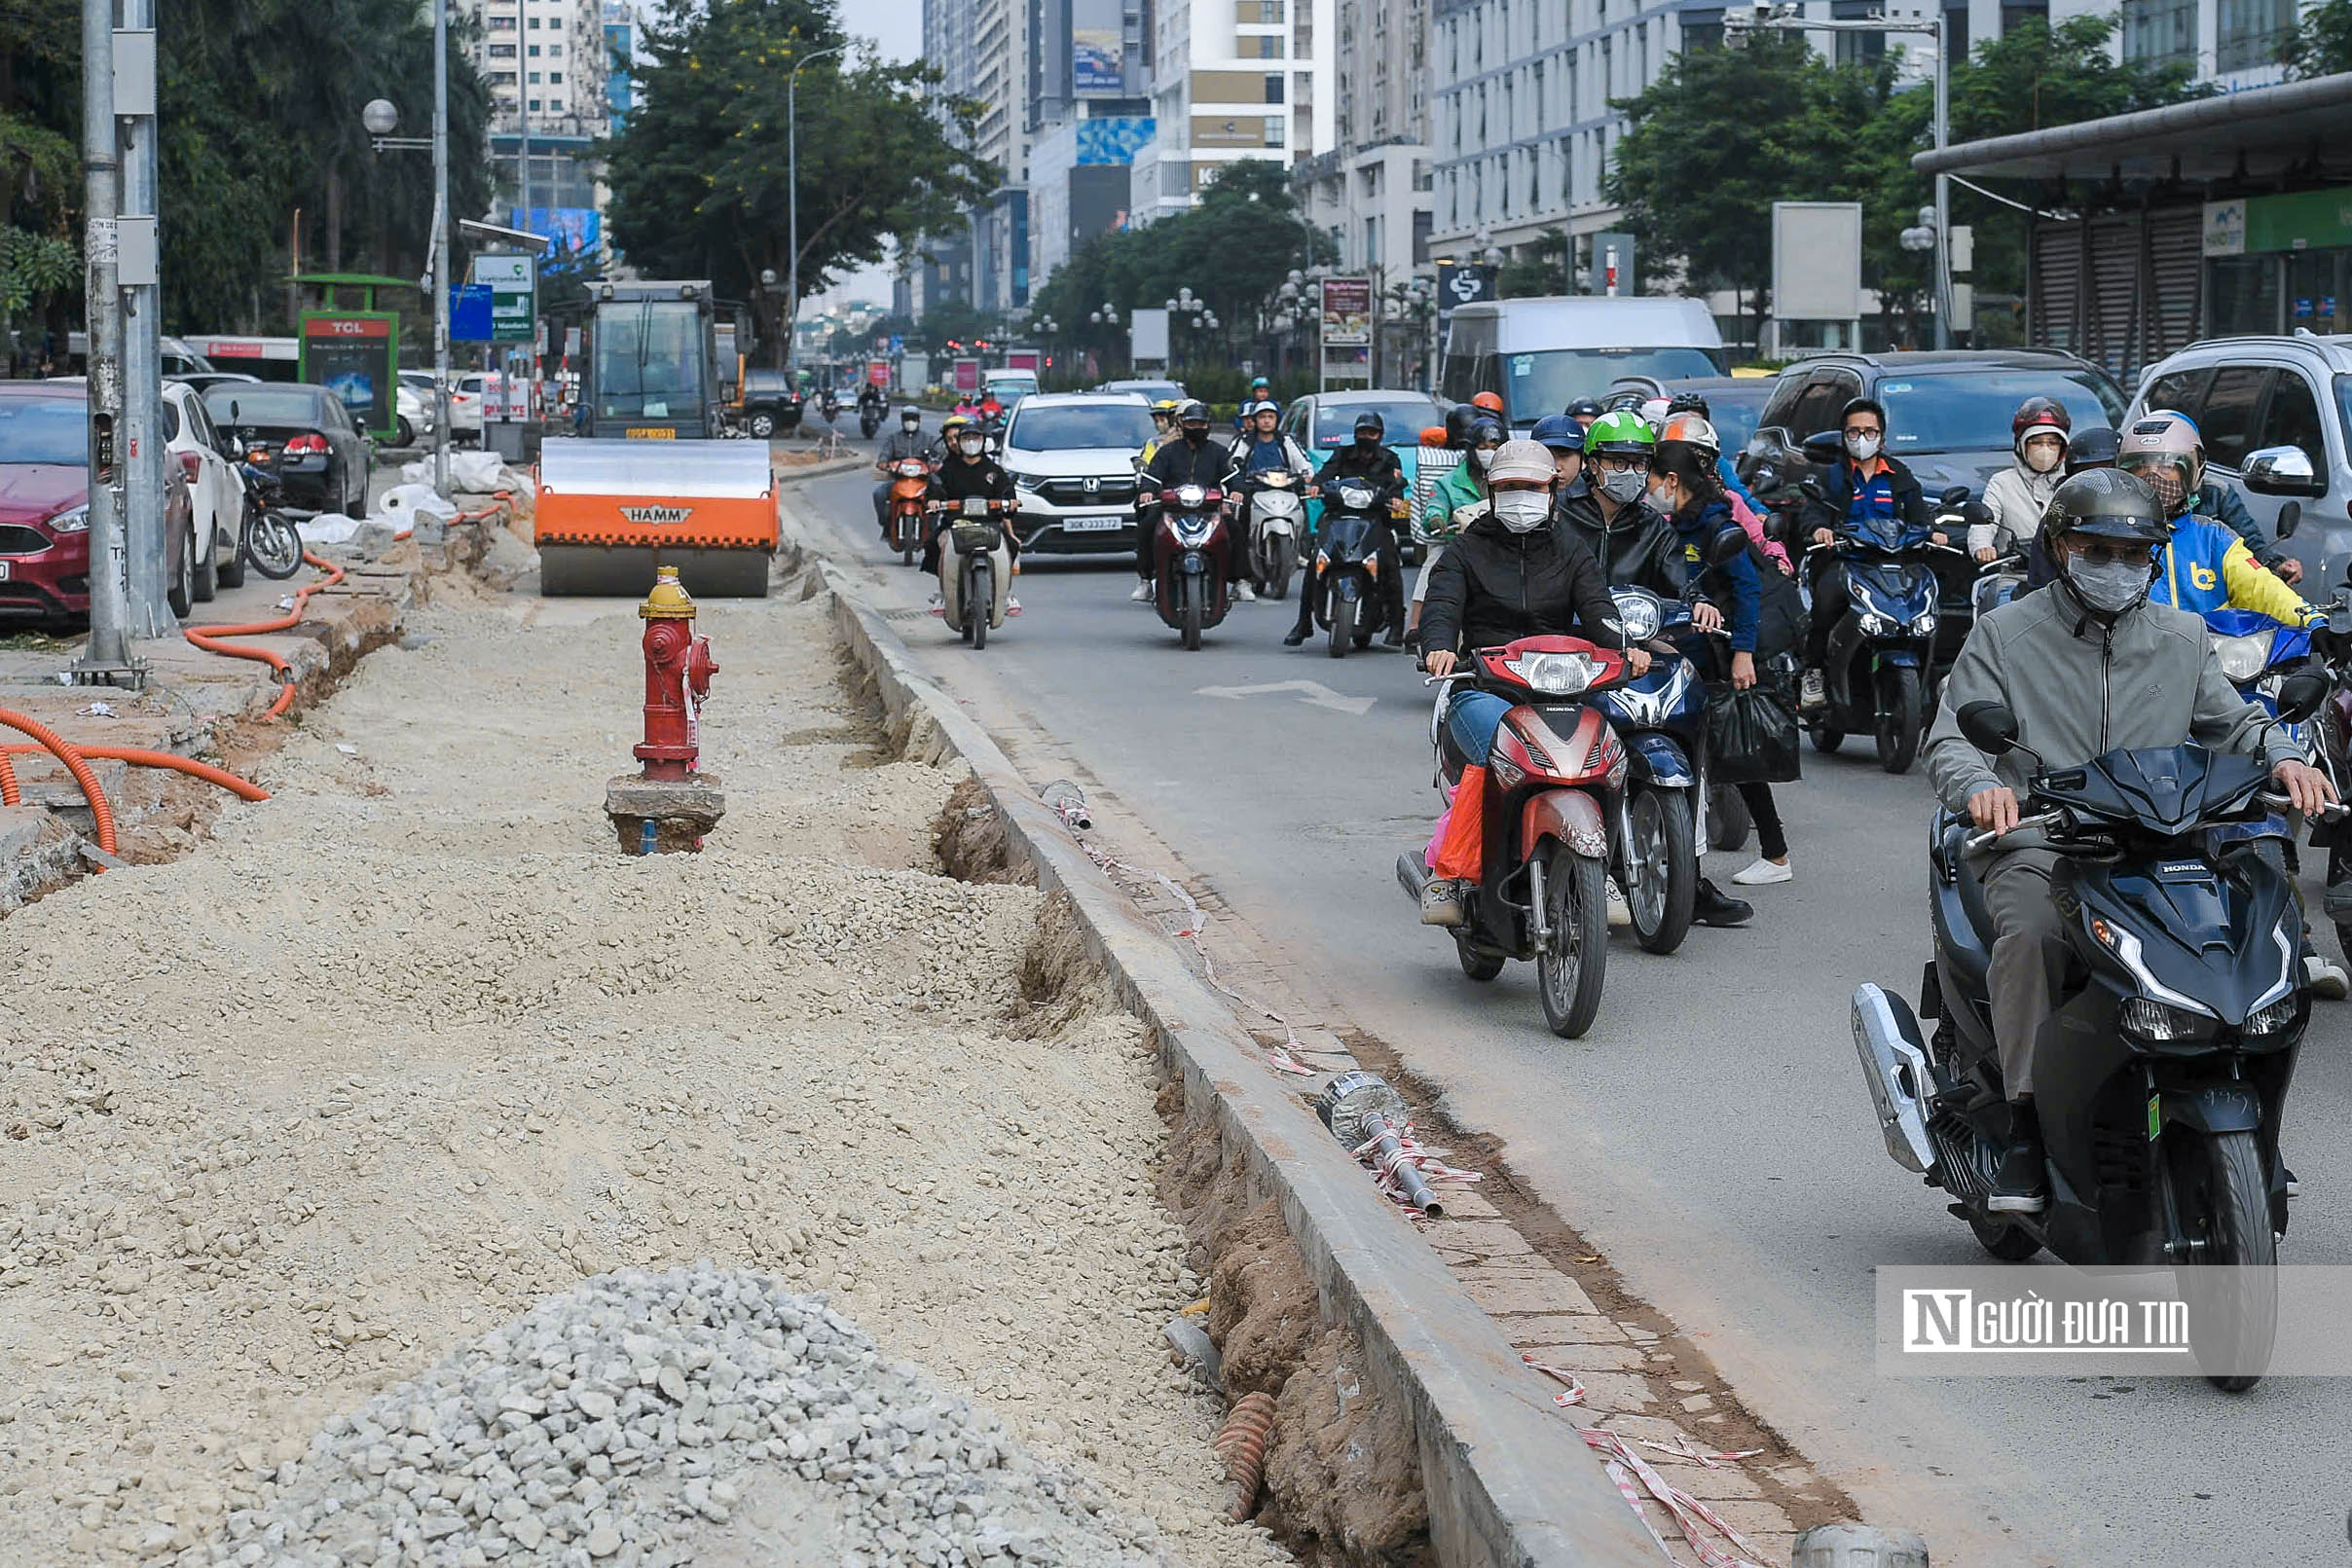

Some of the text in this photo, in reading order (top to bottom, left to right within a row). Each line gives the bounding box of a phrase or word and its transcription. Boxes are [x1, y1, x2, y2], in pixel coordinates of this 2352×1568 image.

[332, 322, 364, 334] TCL
[631, 509, 681, 521] HAMM
[2162, 864, 2208, 873] HONDA
